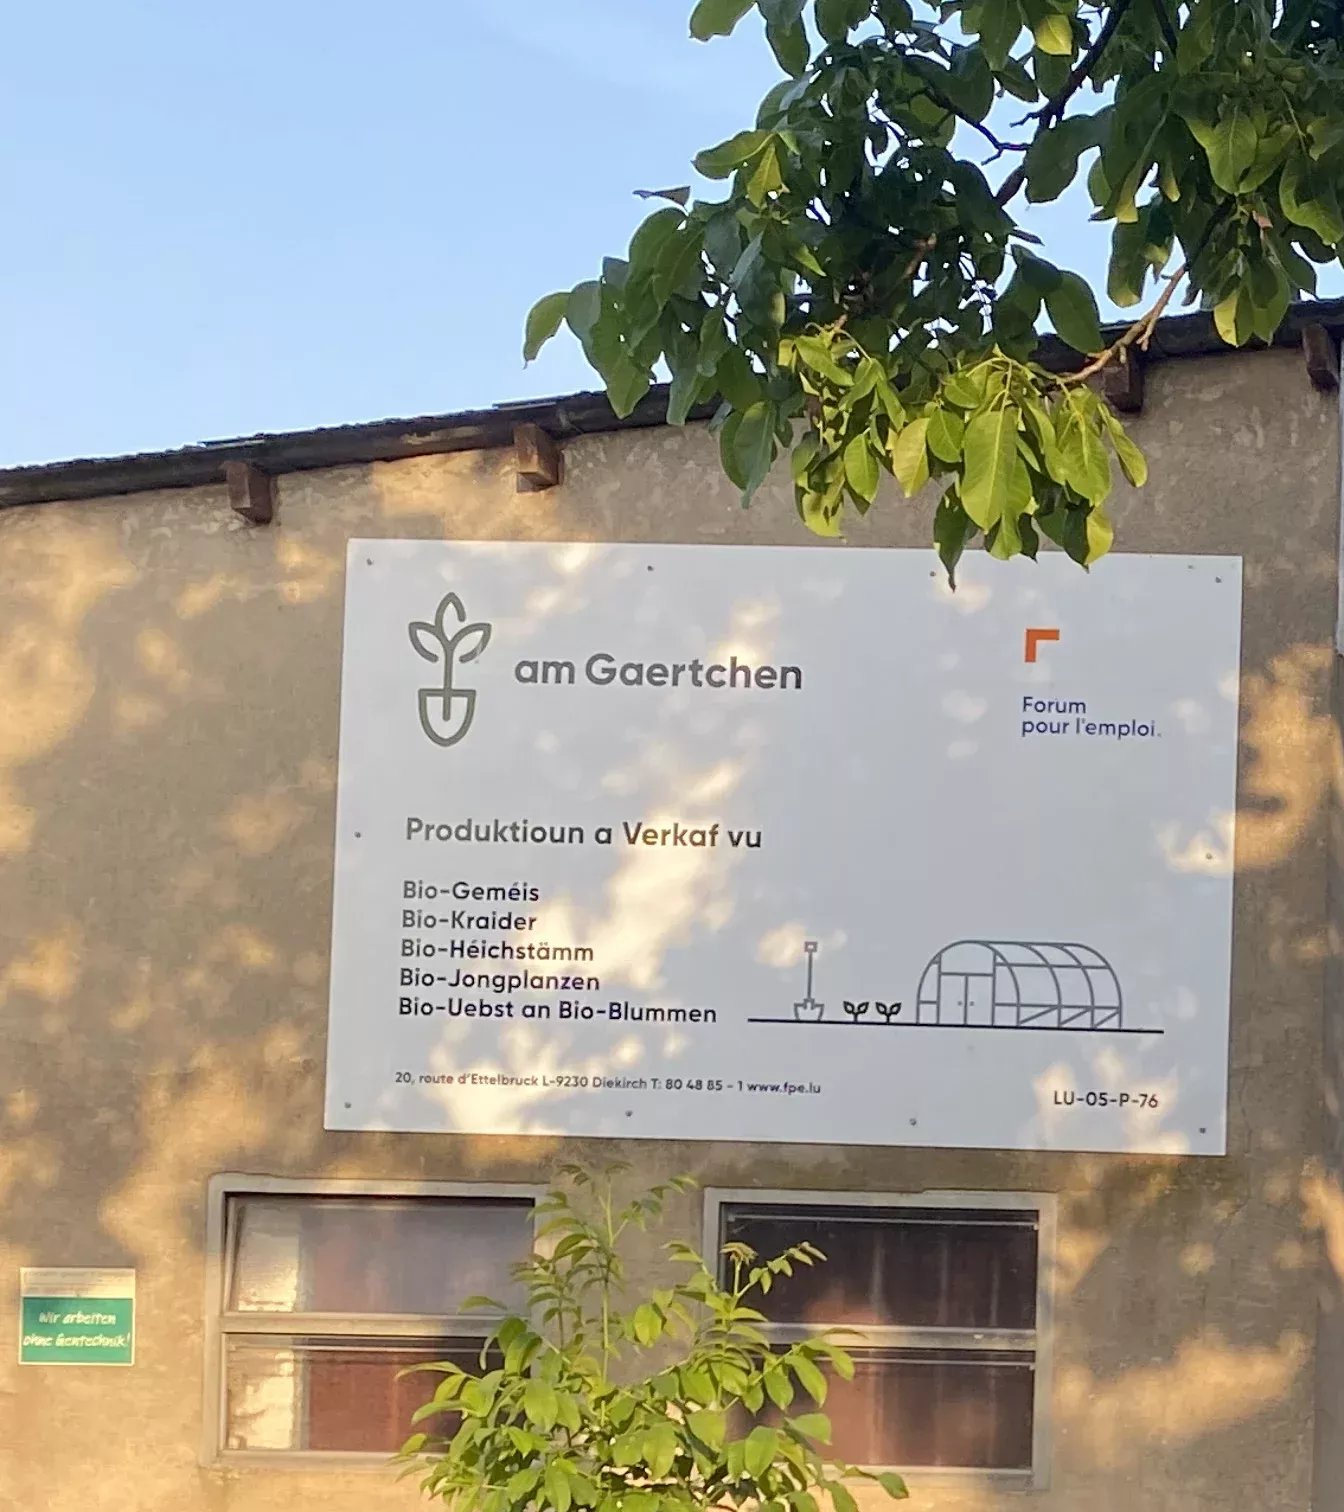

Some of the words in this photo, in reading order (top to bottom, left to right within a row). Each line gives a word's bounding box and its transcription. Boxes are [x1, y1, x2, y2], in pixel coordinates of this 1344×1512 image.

[514, 658, 576, 685] am
[585, 652, 803, 690] Gaertchen
[1022, 695, 1087, 714] Forum
[1021, 720, 1070, 738] pour
[405, 816, 585, 845] Produktioun
[594, 826, 613, 845] a
[622, 820, 720, 847] Verkaf
[727, 828, 763, 849] vu
[403, 880, 540, 902] Bio-Geméis
[402, 909, 537, 931] Bio-Kraider
[400, 938, 595, 962] Bio-Héichstämm
[399, 967, 601, 994] Bio-Jongplanzen
[398, 997, 514, 1019] Bio-Uebst
[521, 1003, 551, 1020] an
[558, 1000, 717, 1023] Bio-Blummen
[395, 1072, 415, 1085] 20,
[418, 1073, 454, 1085] route
[457, 1073, 539, 1086] d'Ettelbruck
[541, 1075, 589, 1088] L-9230
[592, 1076, 647, 1089] Diekirch
[650, 1078, 662, 1090] T:
[665, 1078, 683, 1090] 80
[685, 1079, 703, 1091] 48
[706, 1079, 723, 1091] 85
[747, 1081, 821, 1095] www.fpe.lu
[1053, 1090, 1160, 1109] LU-05-P-76
